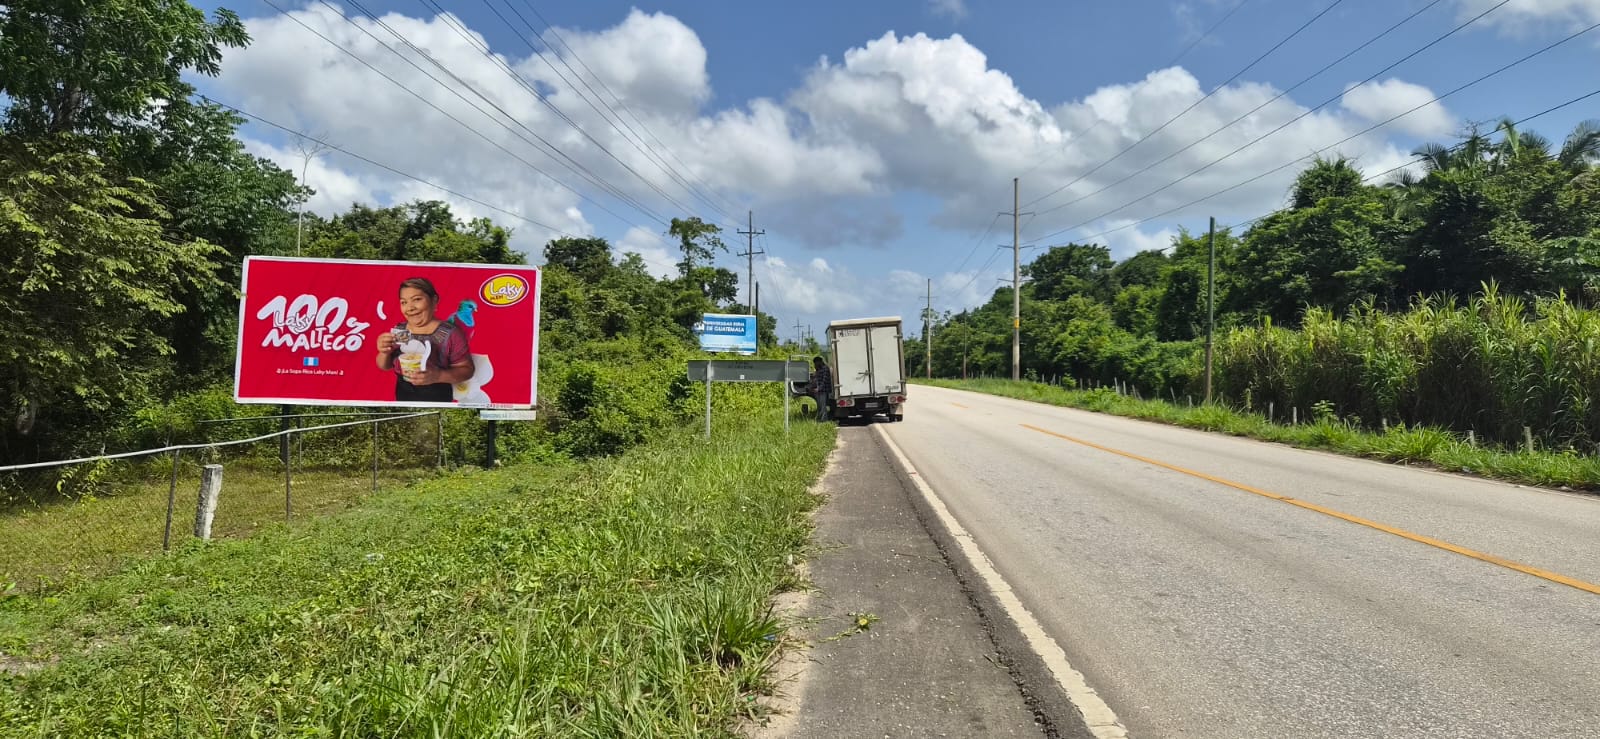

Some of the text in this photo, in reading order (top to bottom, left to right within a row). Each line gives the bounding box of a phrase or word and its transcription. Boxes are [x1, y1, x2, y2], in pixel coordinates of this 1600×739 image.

[489, 281, 522, 299] Laky
[274, 310, 318, 334] Laky
[261, 327, 363, 353] MALTECO
